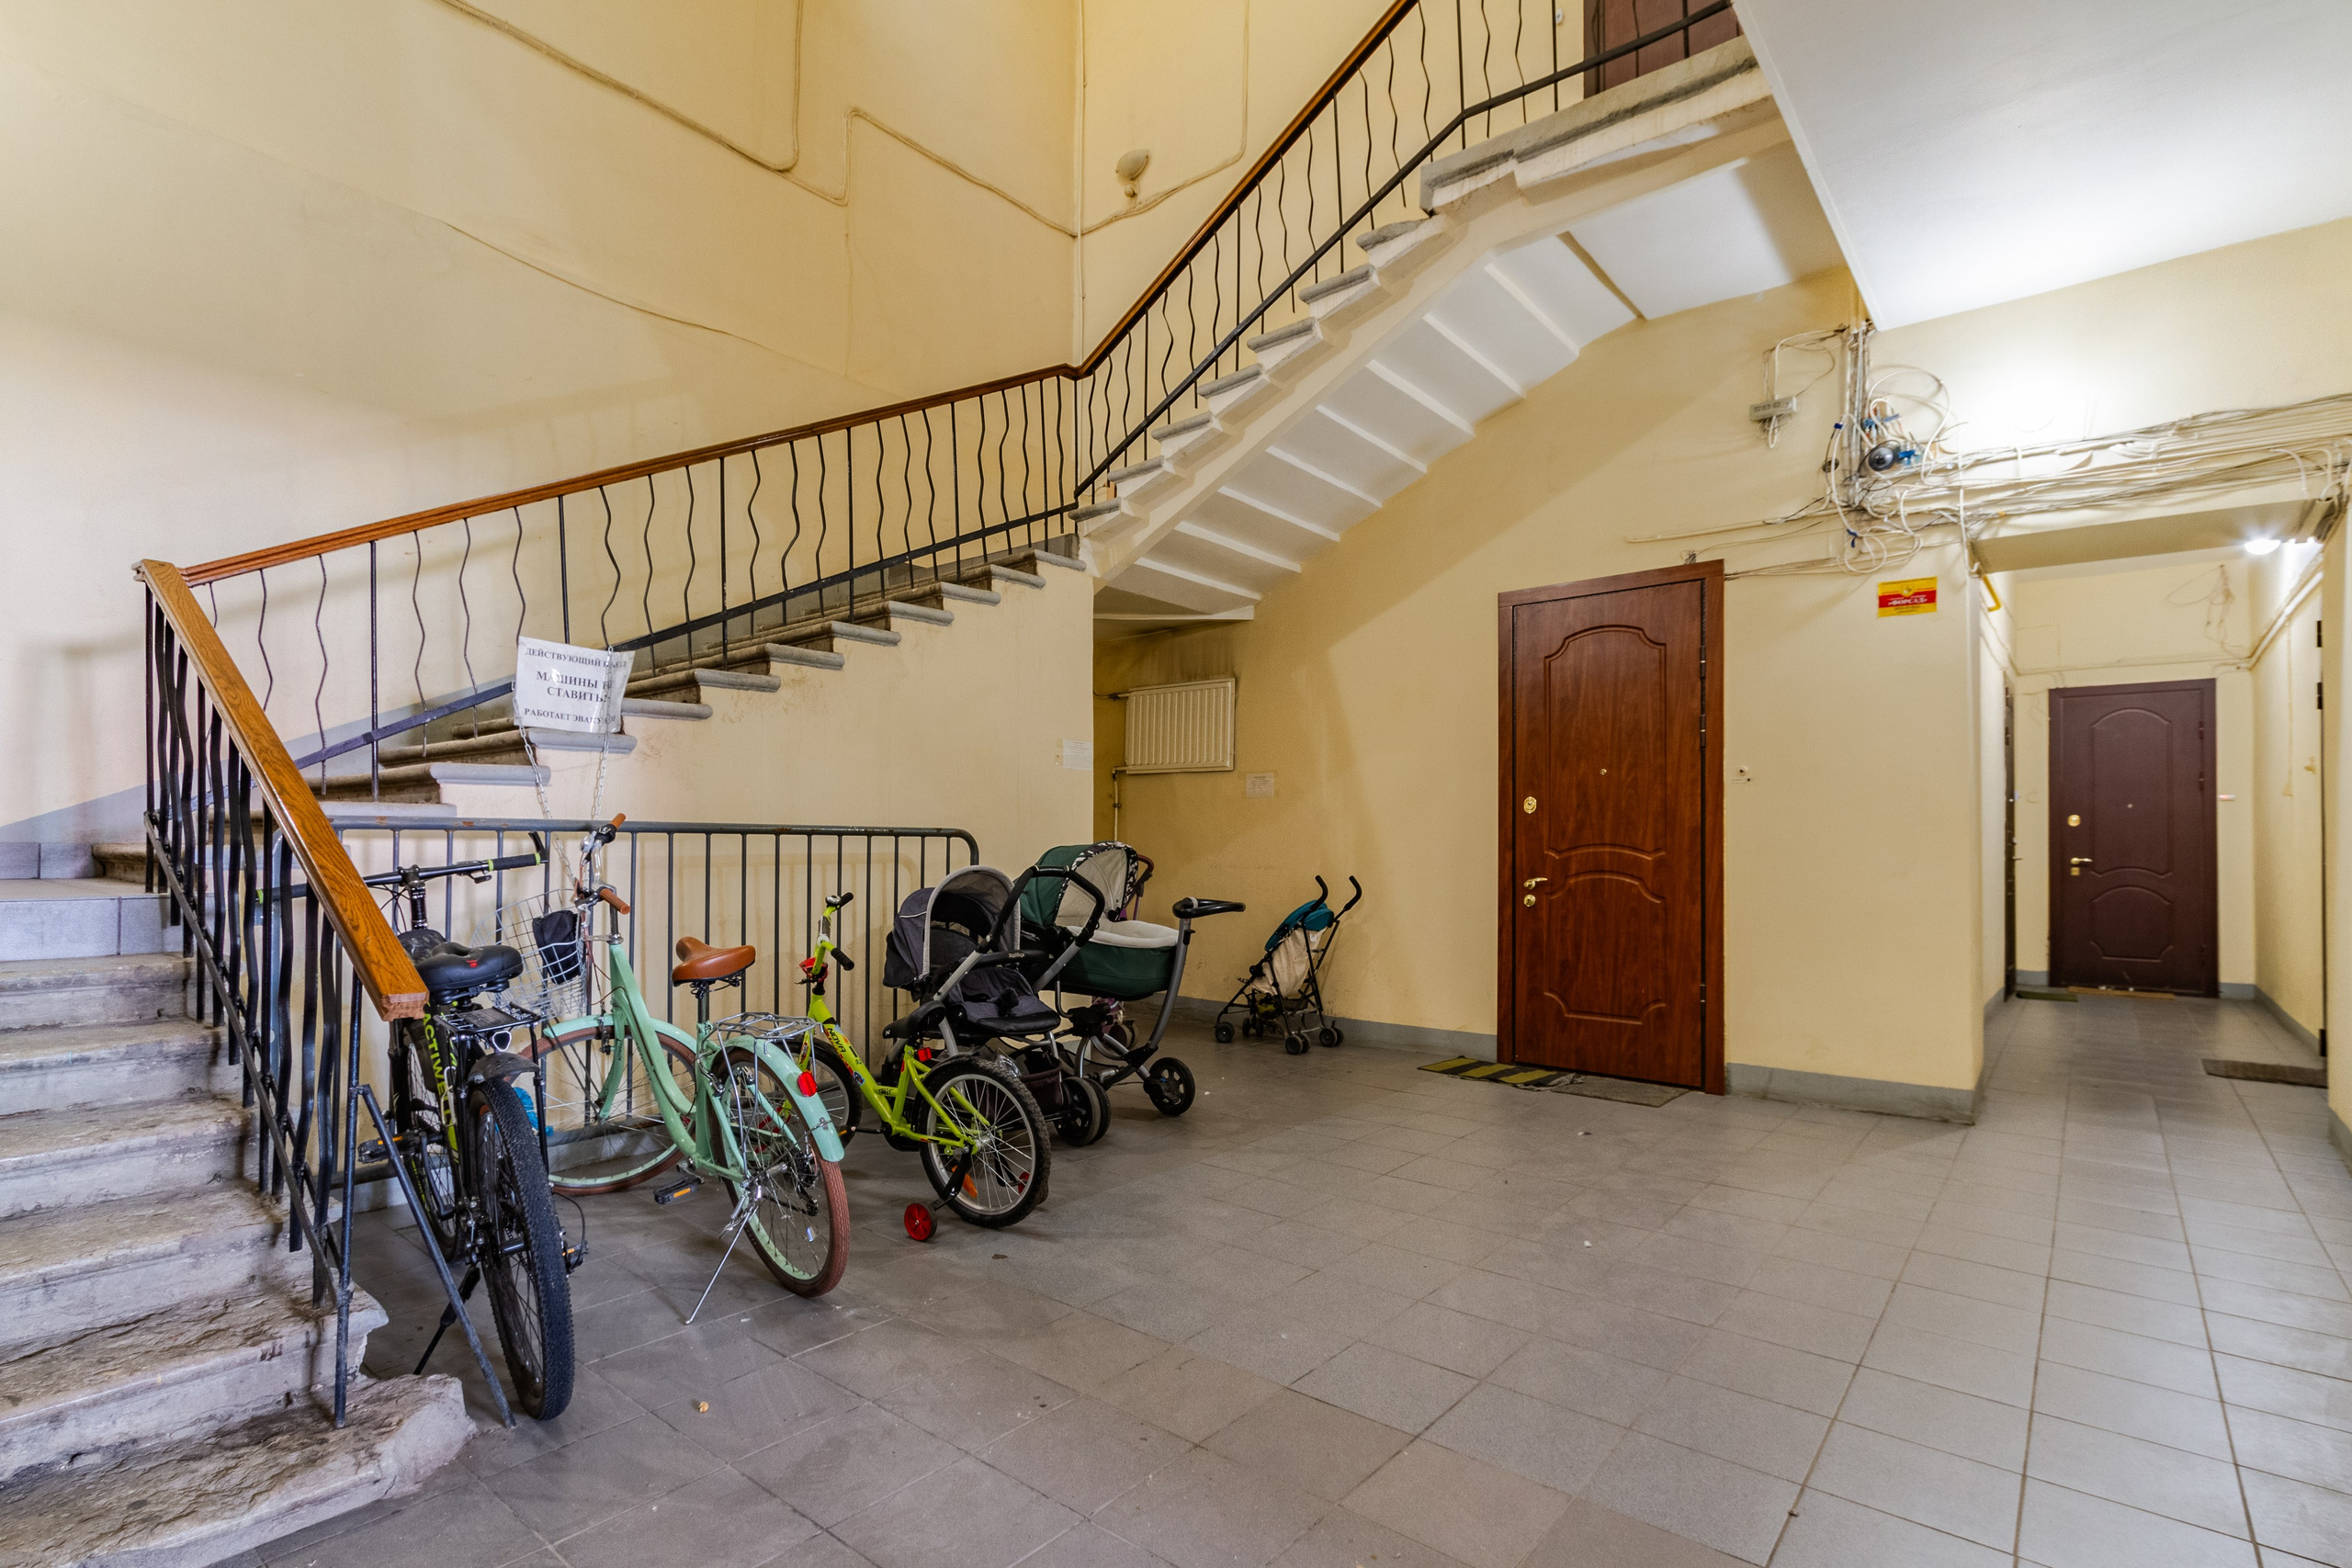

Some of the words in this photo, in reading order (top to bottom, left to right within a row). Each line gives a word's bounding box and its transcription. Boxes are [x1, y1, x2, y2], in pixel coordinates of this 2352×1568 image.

[526, 648, 601, 667] ДЕЙСТВУЮЩИЙ
[547, 686, 606, 703] СТАВИТЬ!
[524, 707, 571, 721] РАБОТАЕТ
[828, 1028, 846, 1053] NOVA
